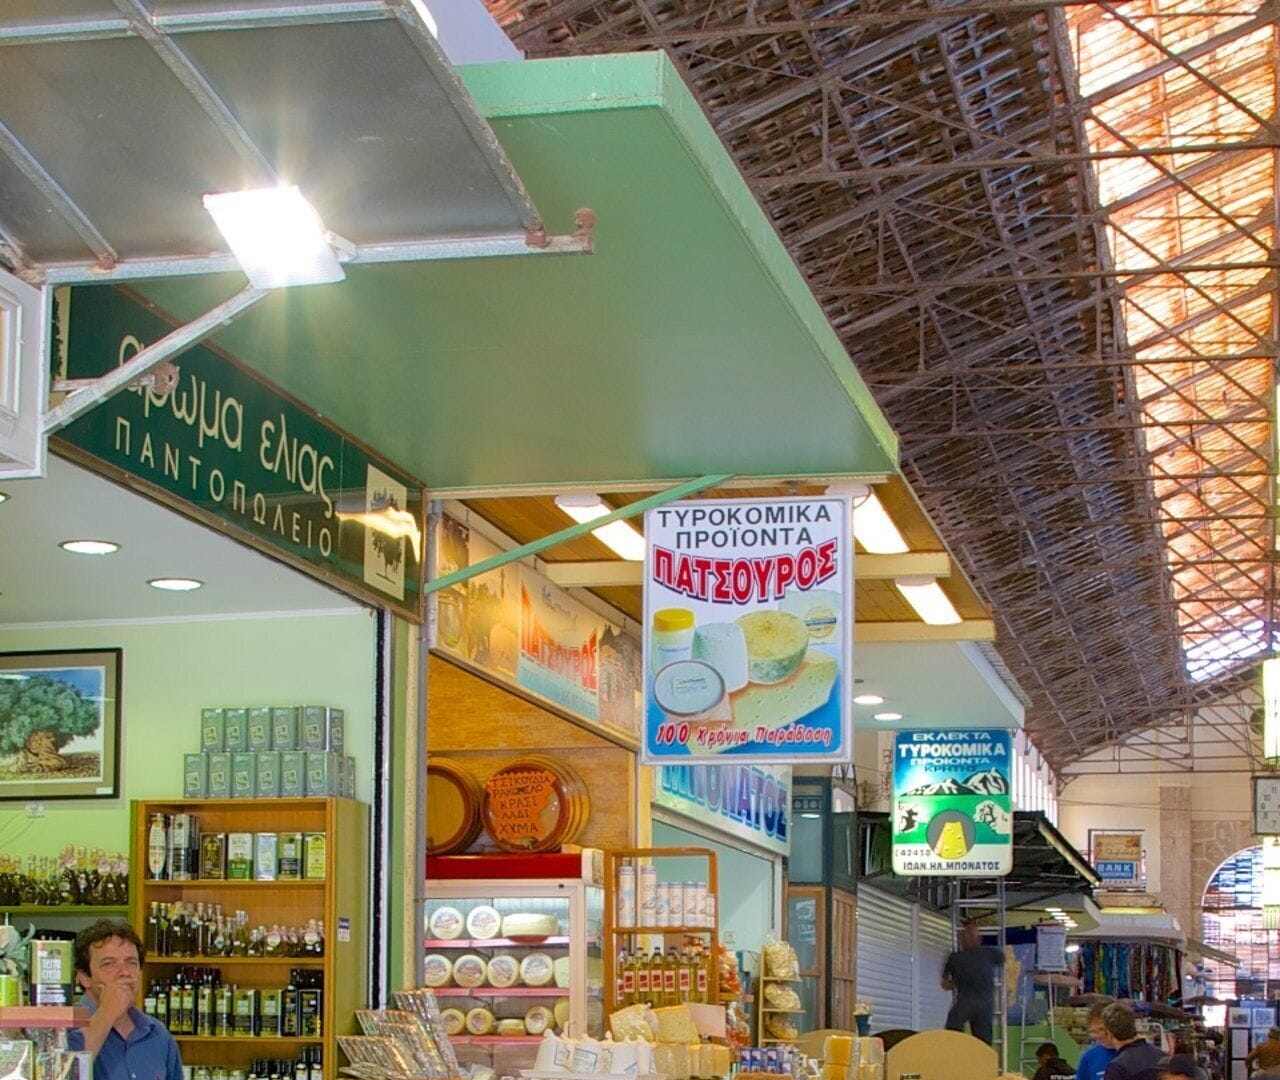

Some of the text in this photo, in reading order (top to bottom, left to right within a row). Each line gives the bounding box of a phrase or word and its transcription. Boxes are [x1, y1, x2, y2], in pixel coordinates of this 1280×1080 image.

[260, 413, 334, 518] ελιας
[116, 416, 332, 557] ΠΑΝΤΟΠΩΛΕΙΟ
[658, 504, 831, 528] ΤΥΡΟΚΟΜΙΚΑ
[676, 527, 812, 549] ΠΡΟΪΟΝΤΑ
[653, 538, 838, 604] ΠΑΤΣΟΥΡΟΣ
[656, 721, 832, 749] 100 Χρόνια Παράδοση
[913, 732, 991, 741] ΕΚΛΕΚΤΑ
[898, 743, 1006, 757] ΤΥΡΟΚΟΜΙΚΑ
[925, 765, 977, 773] ΚΡΗΤΗΣ
[490, 776, 551, 788] ΤΣΙΚΟΥΔΙΑ
[501, 798, 537, 810] ΚΡΑΣΙ
[502, 810, 529, 819] ΛΑΔΙ
[499, 823, 539, 835] ΧΥΜΑ
[946, 862, 1000, 870] ΜΠΟΝΑΤΟΣ
[1097, 864, 1132, 872] BANK
